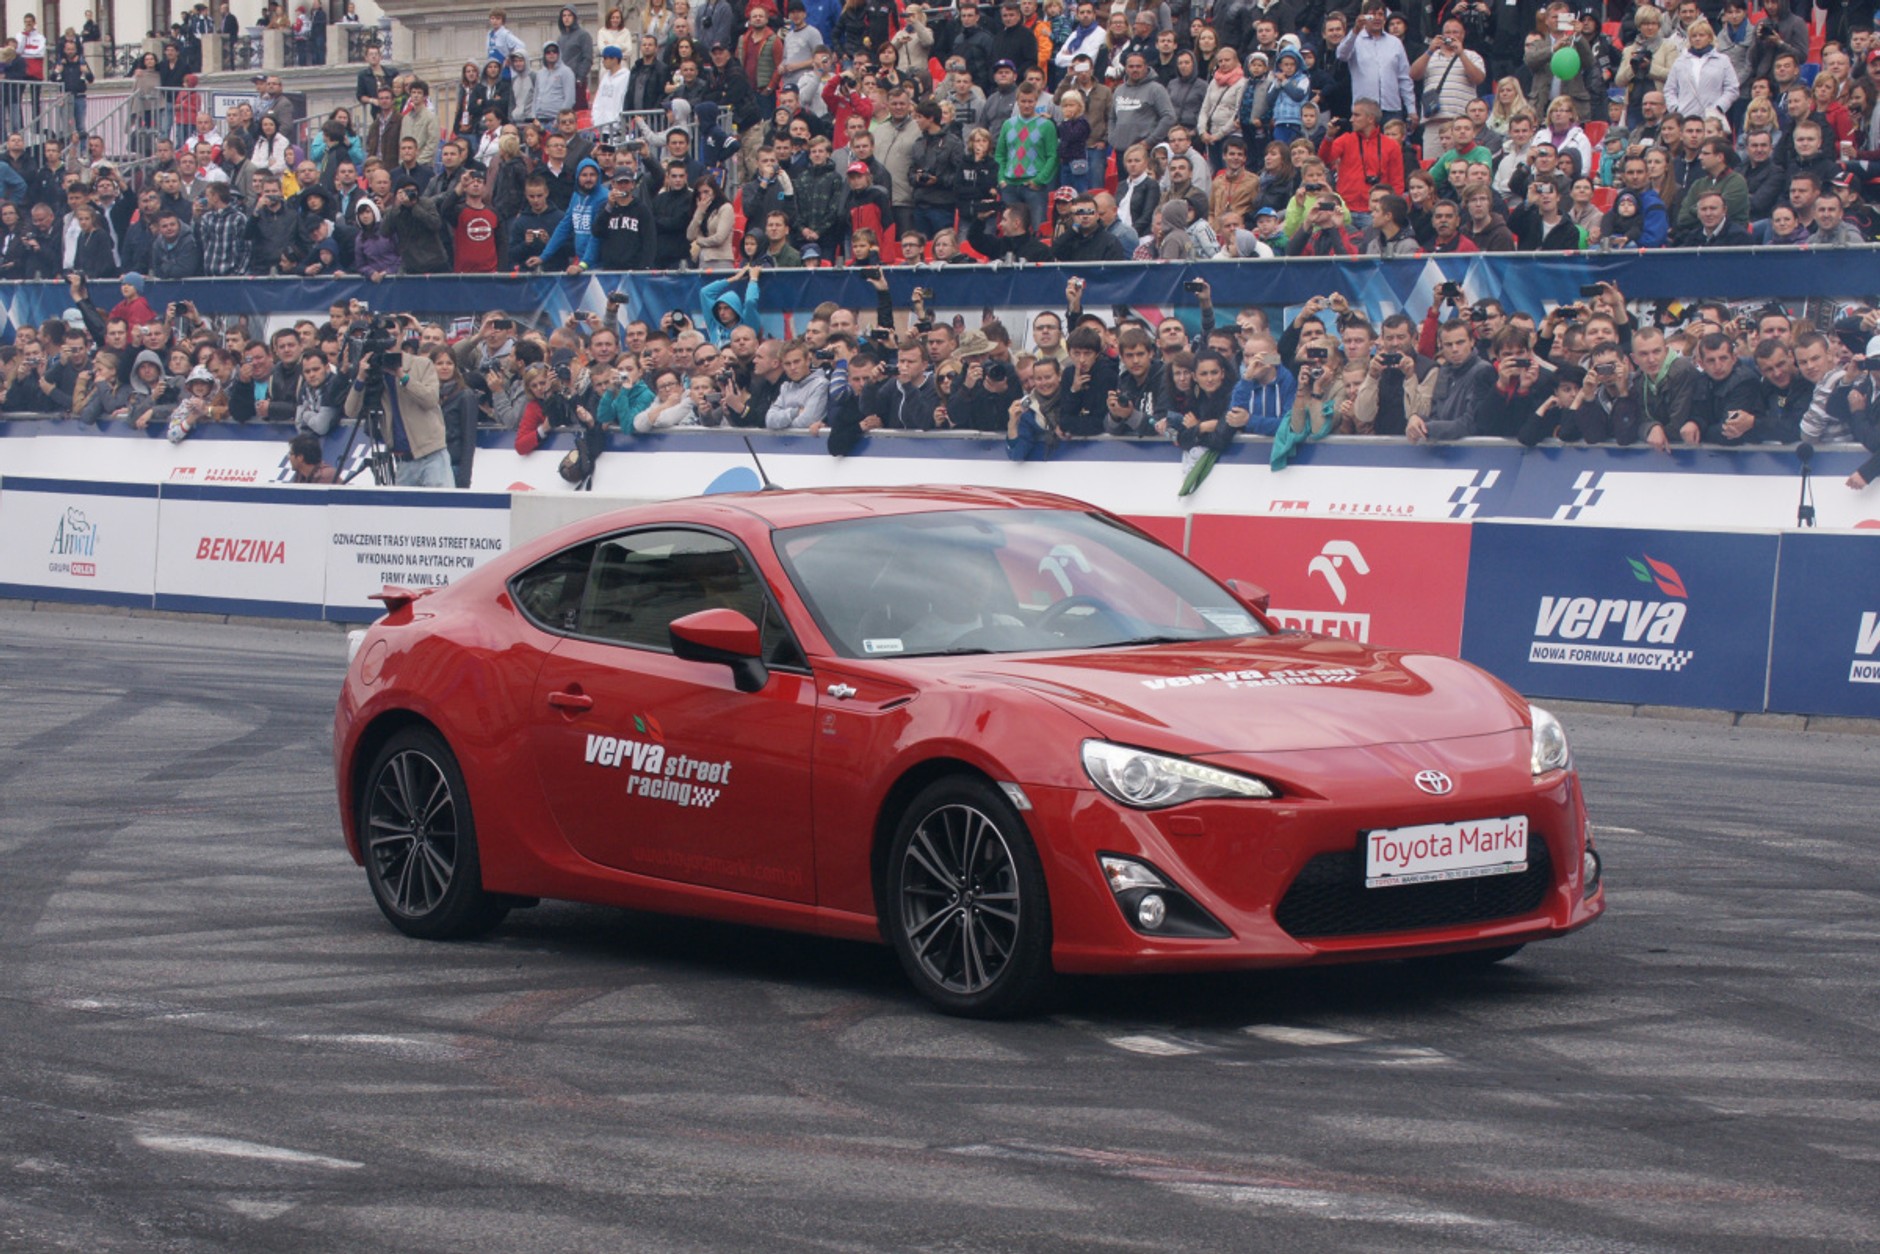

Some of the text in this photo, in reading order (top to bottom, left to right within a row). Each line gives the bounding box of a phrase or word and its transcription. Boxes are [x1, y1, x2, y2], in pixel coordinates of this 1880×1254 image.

[608, 215, 639, 233] NIKE
[196, 537, 285, 564] BENZINA
[332, 533, 502, 550] OZNACZENIE TRASY VERVA STREET RACING
[356, 553, 474, 568] WYKONANO NA PŁYTACH PCW
[380, 572, 406, 584] FIRMY
[407, 573, 434, 585] ANWIL
[1534, 595, 1688, 644] verva
[1532, 647, 1662, 666] NOWA FORMUŁA MOCY
[1141, 669, 1266, 690] verva
[585, 733, 732, 784] verva street
[626, 774, 692, 807] racing
[1371, 822, 1524, 868] Toyota Marki
